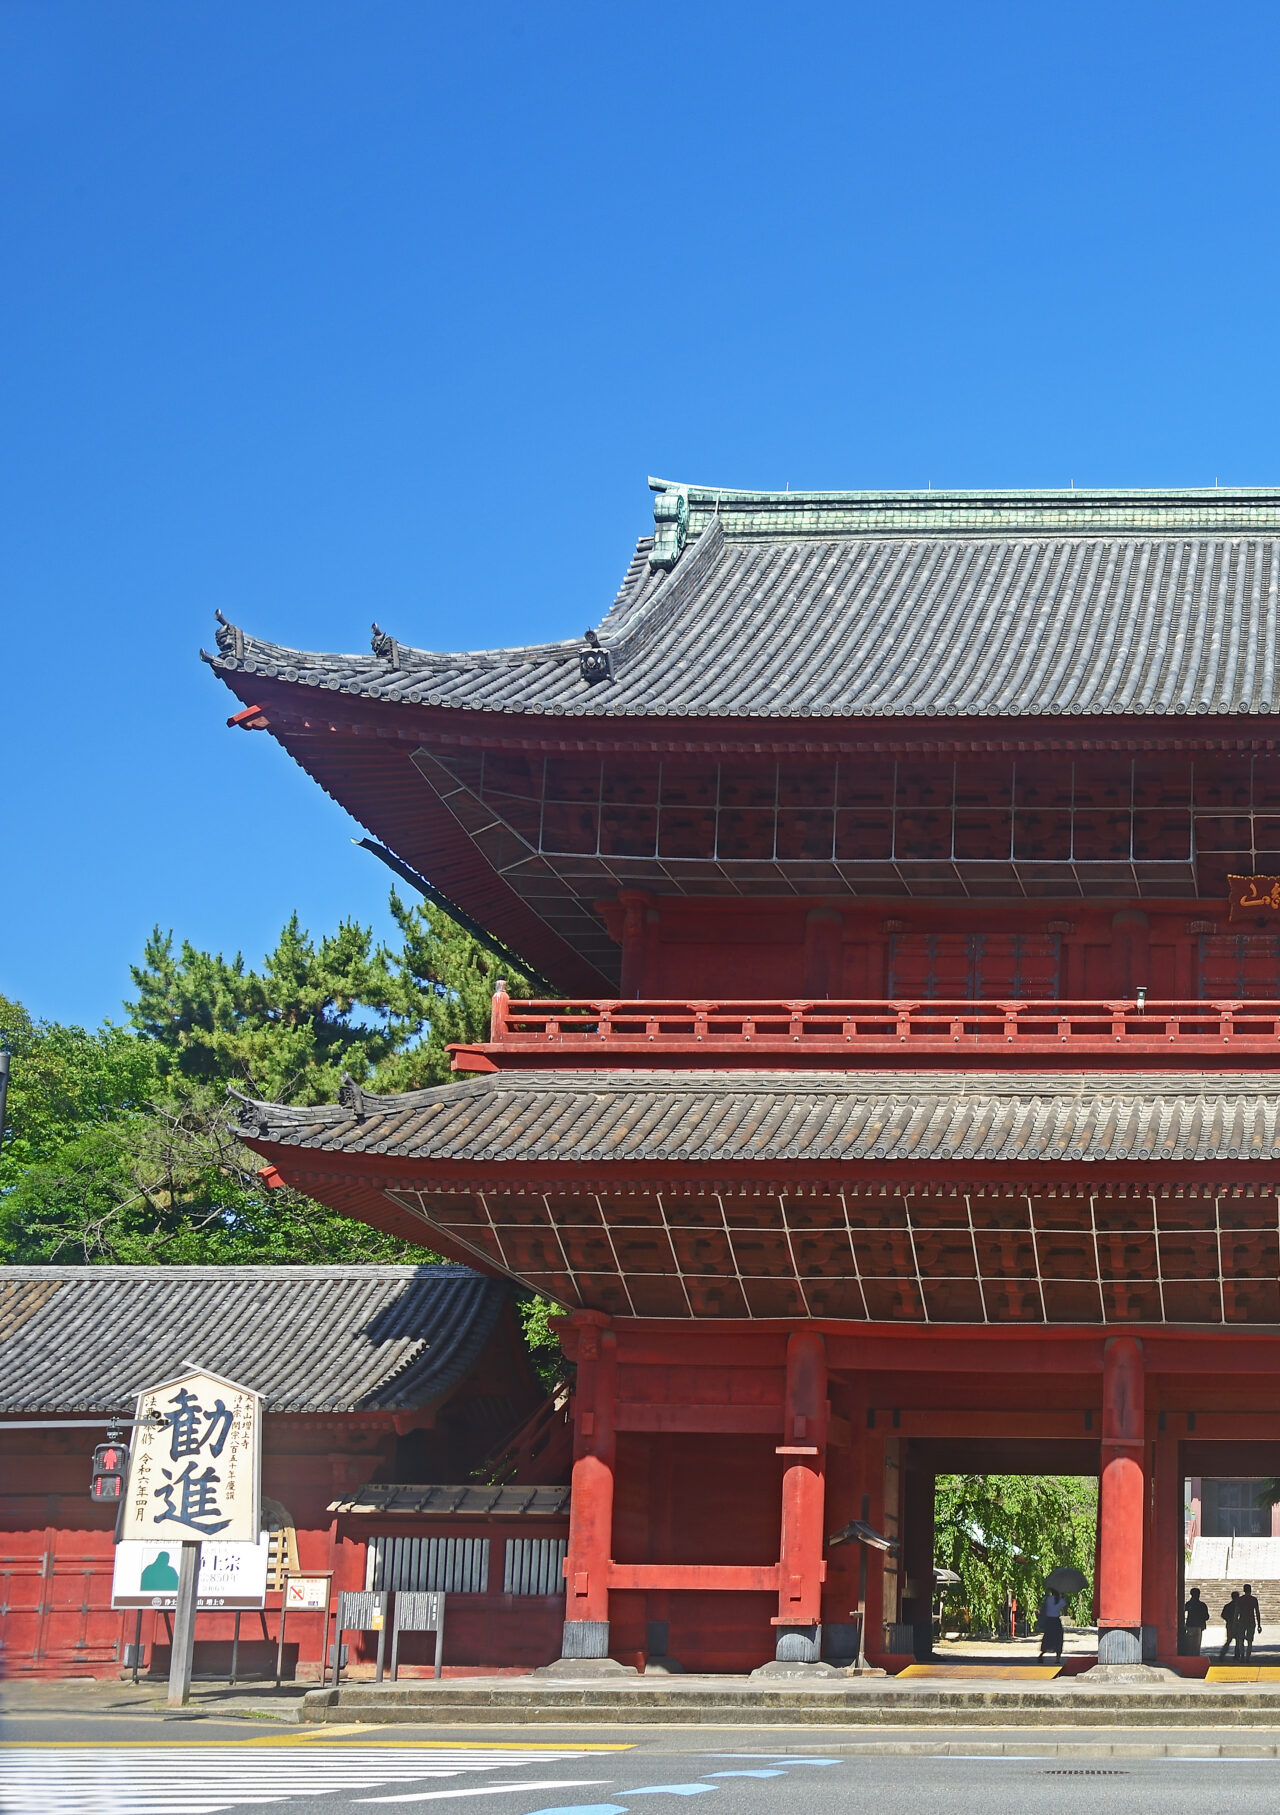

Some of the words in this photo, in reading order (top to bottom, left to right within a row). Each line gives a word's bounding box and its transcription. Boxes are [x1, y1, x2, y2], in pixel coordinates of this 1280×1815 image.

[241, 1394, 254, 1450] 大本山増上寺
[135, 1453, 152, 1522] 令和六年四月
[153, 1387, 234, 1535] 勧進
